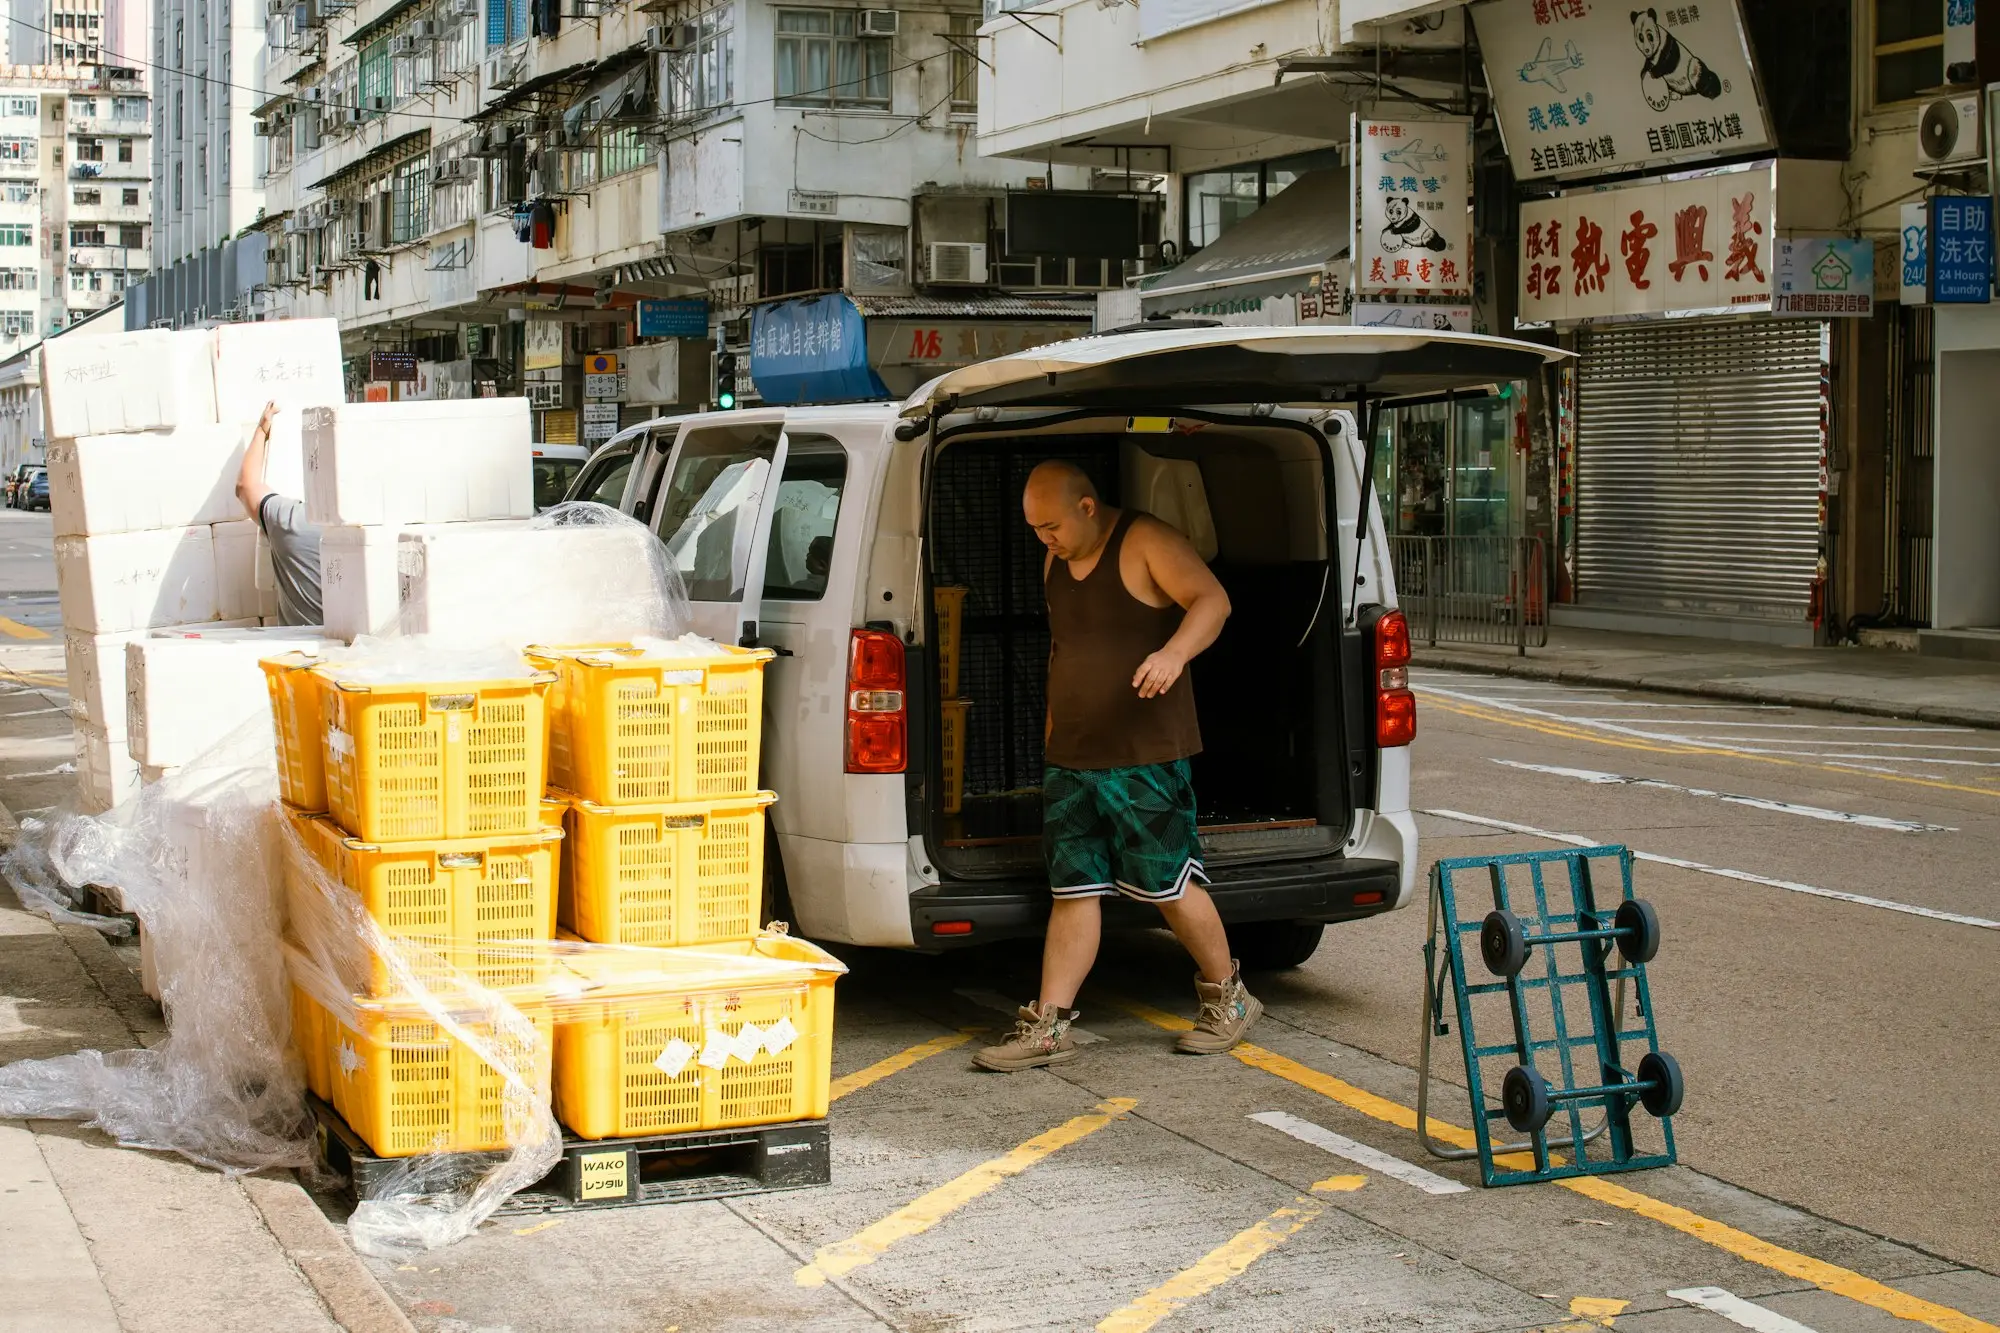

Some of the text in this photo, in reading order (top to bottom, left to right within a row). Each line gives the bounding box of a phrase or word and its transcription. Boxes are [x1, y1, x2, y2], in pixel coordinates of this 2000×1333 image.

[1665, 4, 1700, 28] 熊貓牌
[1941, 205, 1986, 232] 自助
[1940, 237, 1985, 264] 洗衣
[1369, 256, 1460, 284] 義興電熱
[1939, 269, 1985, 281] 24 Hours
[1941, 284, 1984, 297] Laundry
[1776, 294, 1870, 312] 九龍國語浸信會
[598, 386, 613, 394] 5-7
[584, 1159, 625, 1172] WAKO
[585, 1179, 624, 1191] レンタル
